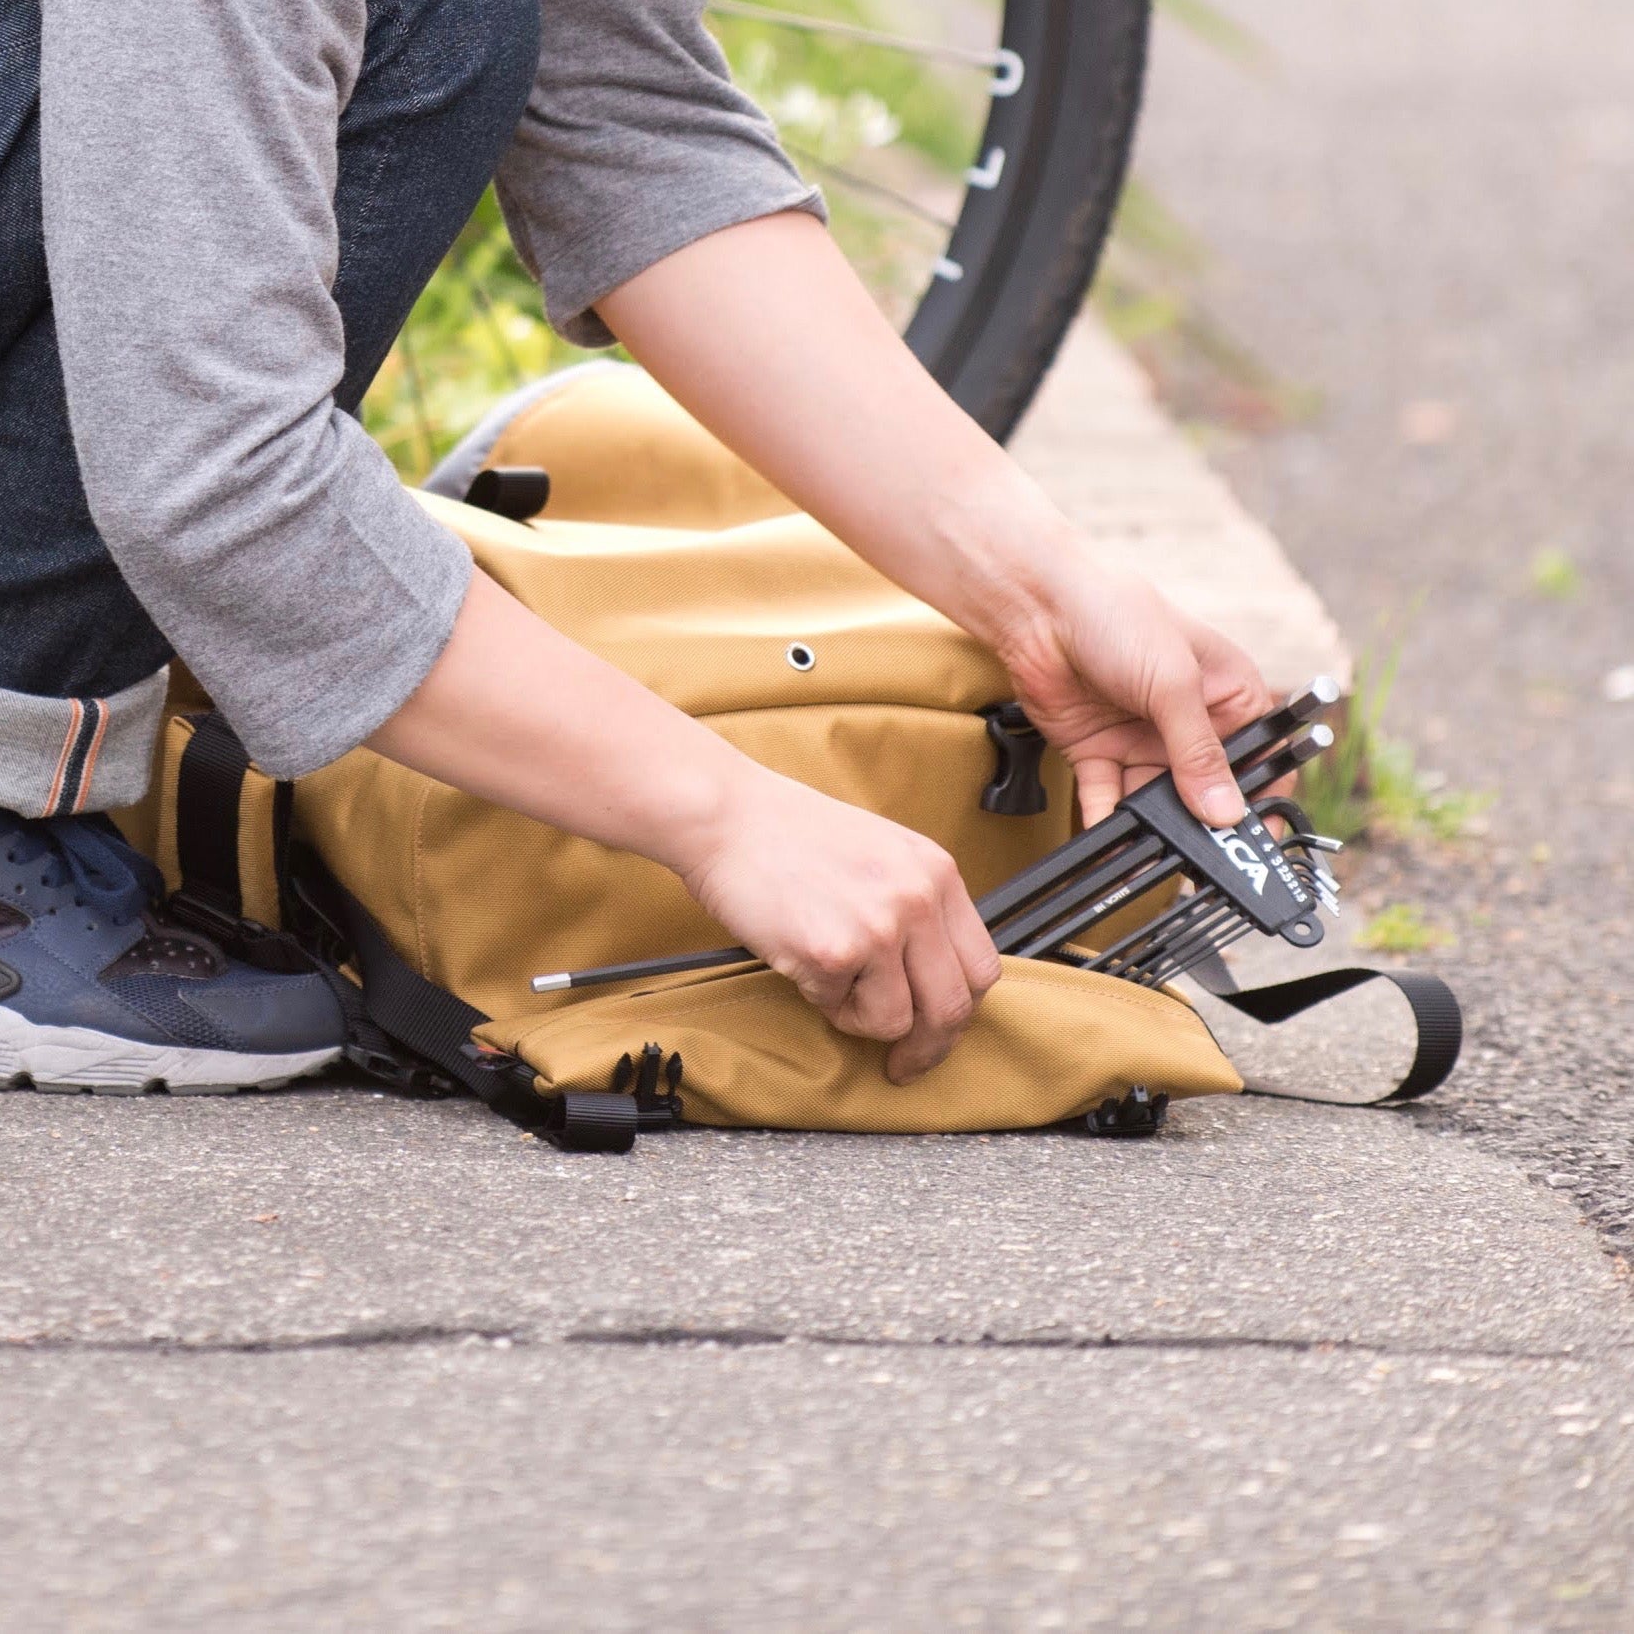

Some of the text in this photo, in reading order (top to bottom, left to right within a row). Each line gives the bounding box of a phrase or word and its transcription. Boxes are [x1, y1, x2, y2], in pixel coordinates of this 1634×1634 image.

[1250, 824, 1264, 836] 5
[1262, 843, 1275, 852] 4
[1270, 855, 1284, 866] 3
